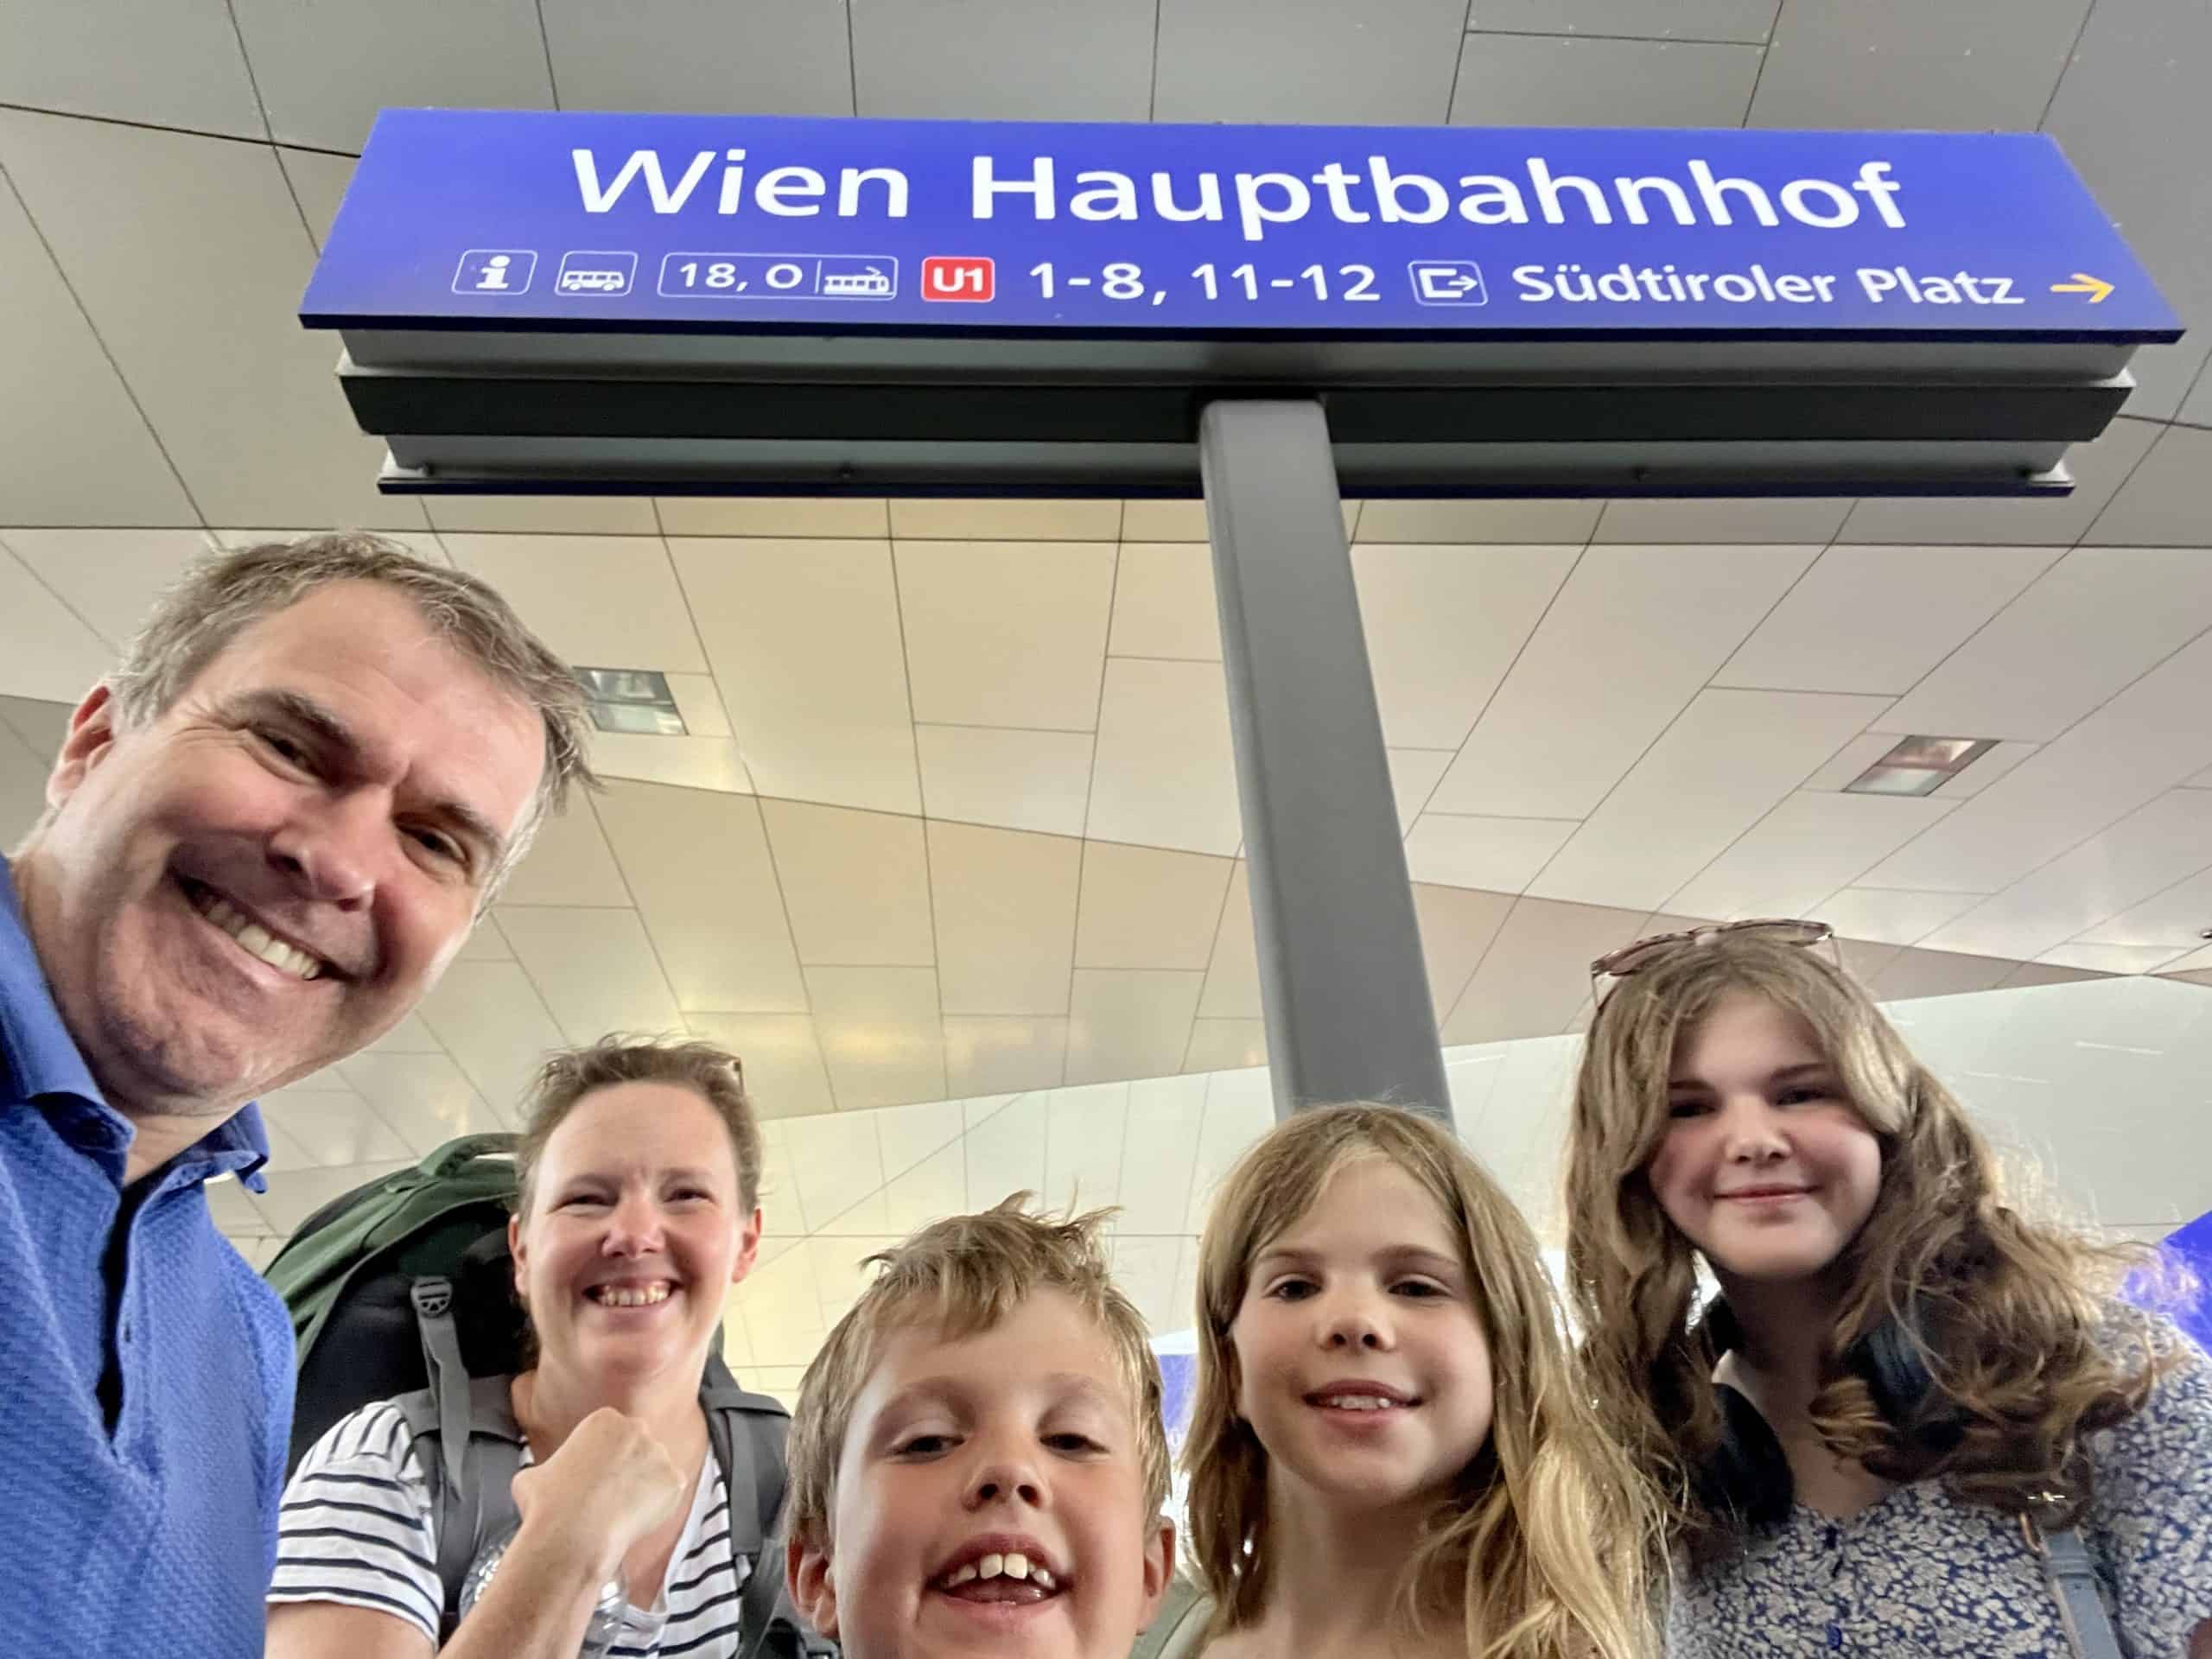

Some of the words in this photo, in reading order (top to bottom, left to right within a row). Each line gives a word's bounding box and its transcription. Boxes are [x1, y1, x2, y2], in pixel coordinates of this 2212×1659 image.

[572, 148, 909, 218] Wien
[972, 156, 1906, 241] Hauptbahnhof
[679, 262, 748, 292] 18,
[932, 266, 984, 292] U1
[1029, 262, 1166, 306] 1-8,
[1192, 263, 1381, 302] 11-12
[1512, 263, 1836, 303] Südtiroler
[1855, 267, 2026, 305] Platz
